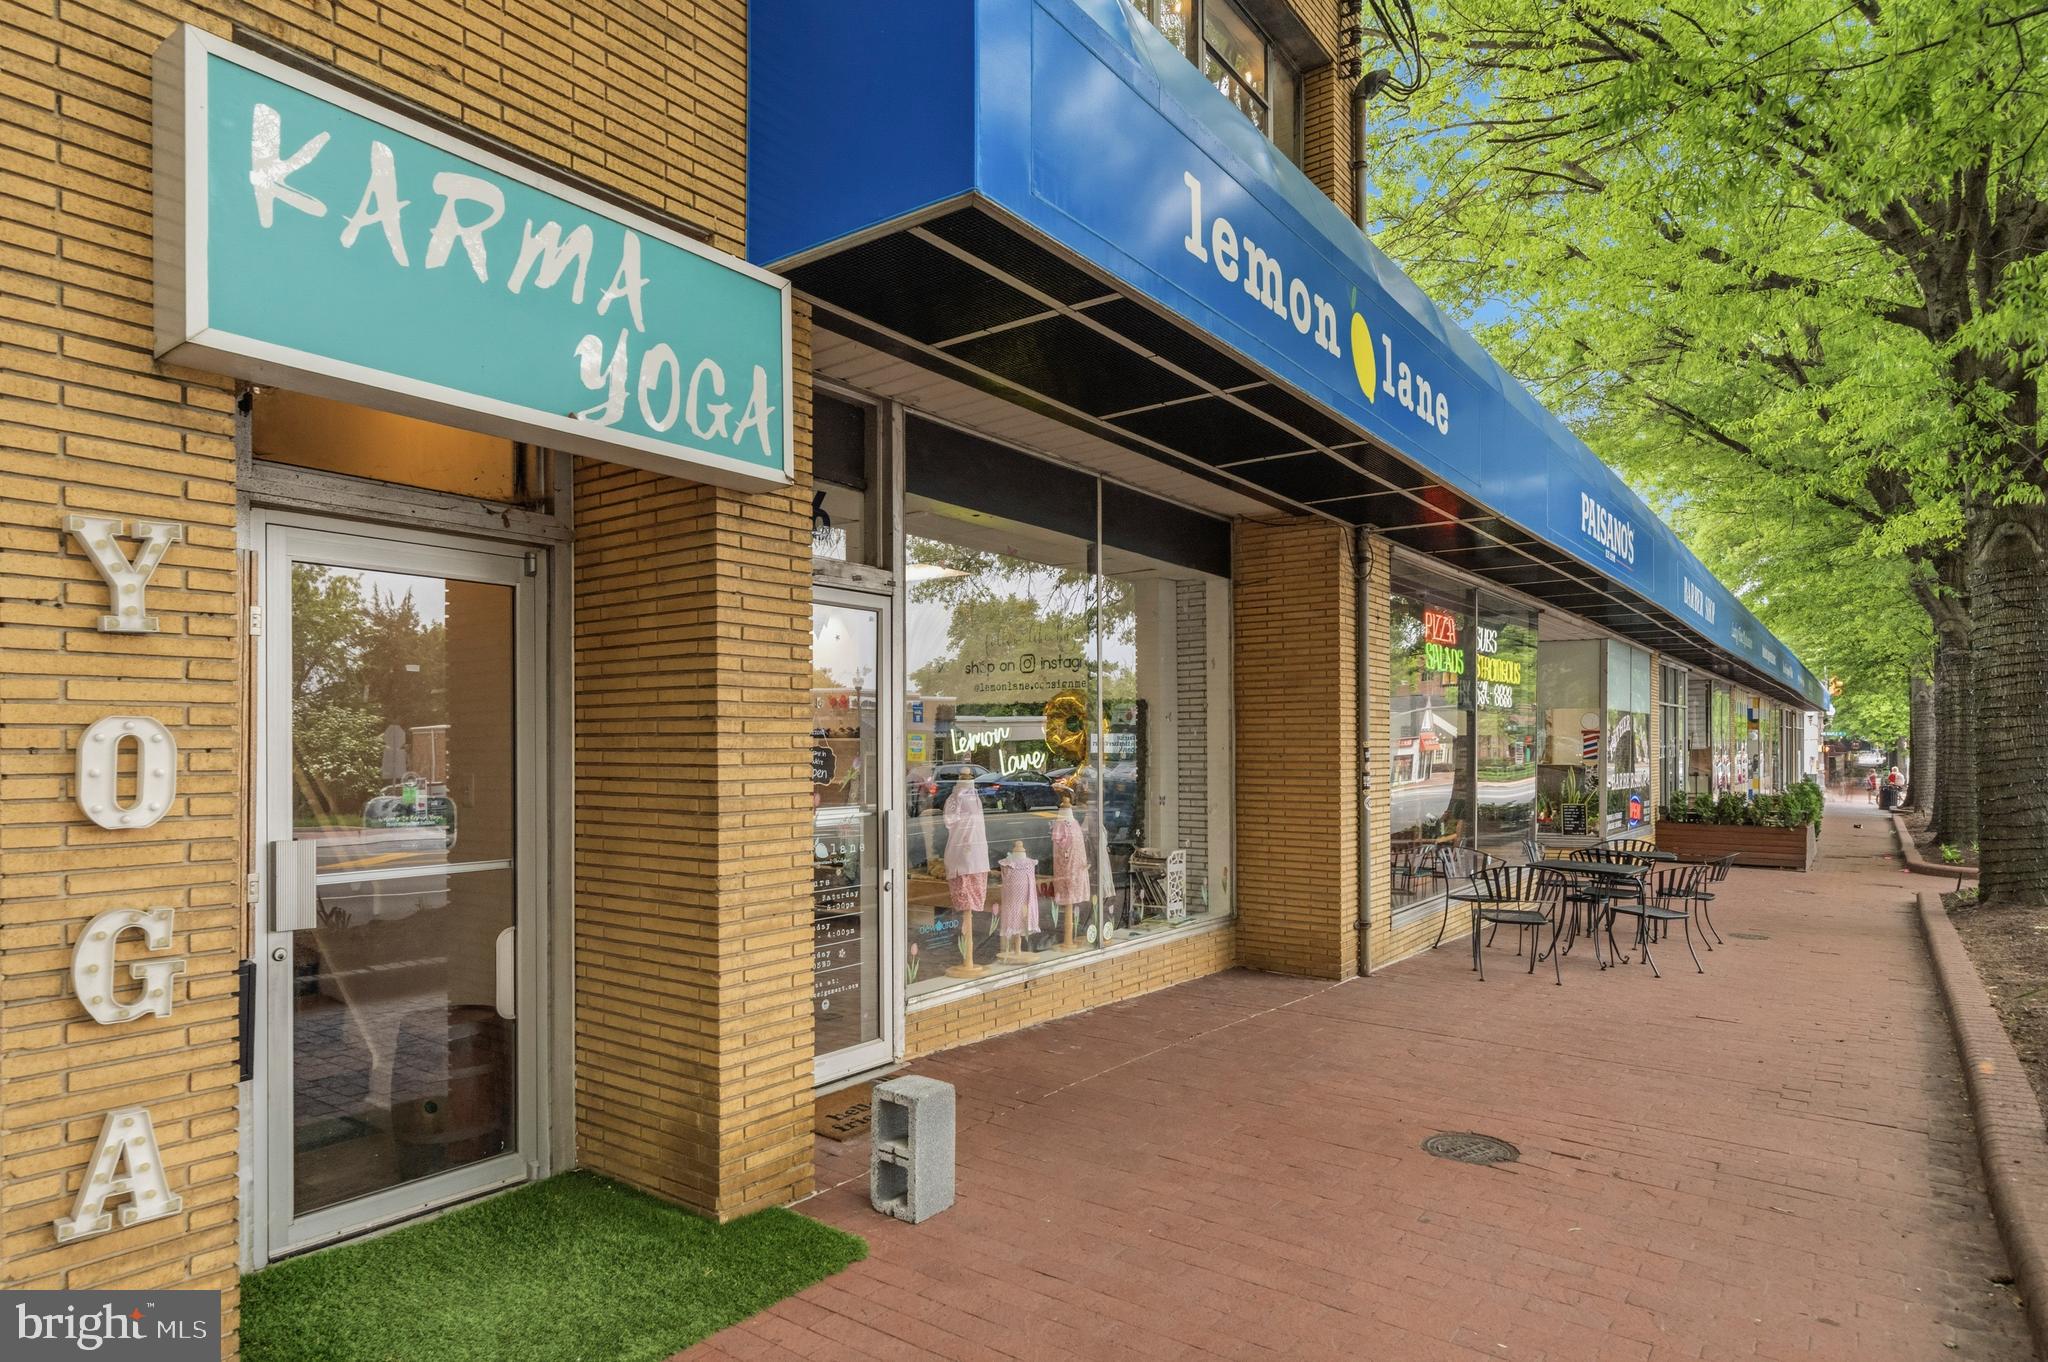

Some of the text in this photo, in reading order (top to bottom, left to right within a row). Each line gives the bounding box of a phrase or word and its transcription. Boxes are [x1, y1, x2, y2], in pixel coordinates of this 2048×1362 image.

[249, 103, 649, 332] KARMA
[1183, 170, 1449, 435] lemon lane
[574, 327, 777, 457] YOGA
[1580, 491, 1635, 565] PAISANO'S
[1424, 611, 1457, 645] PIZZA
[1000, 661, 1015, 672] on
[1425, 642, 1465, 676] SALADS
[951, 727, 1010, 754] Lemon
[812, 769, 828, 779] pen
[999, 749, 1046, 776] Lane
